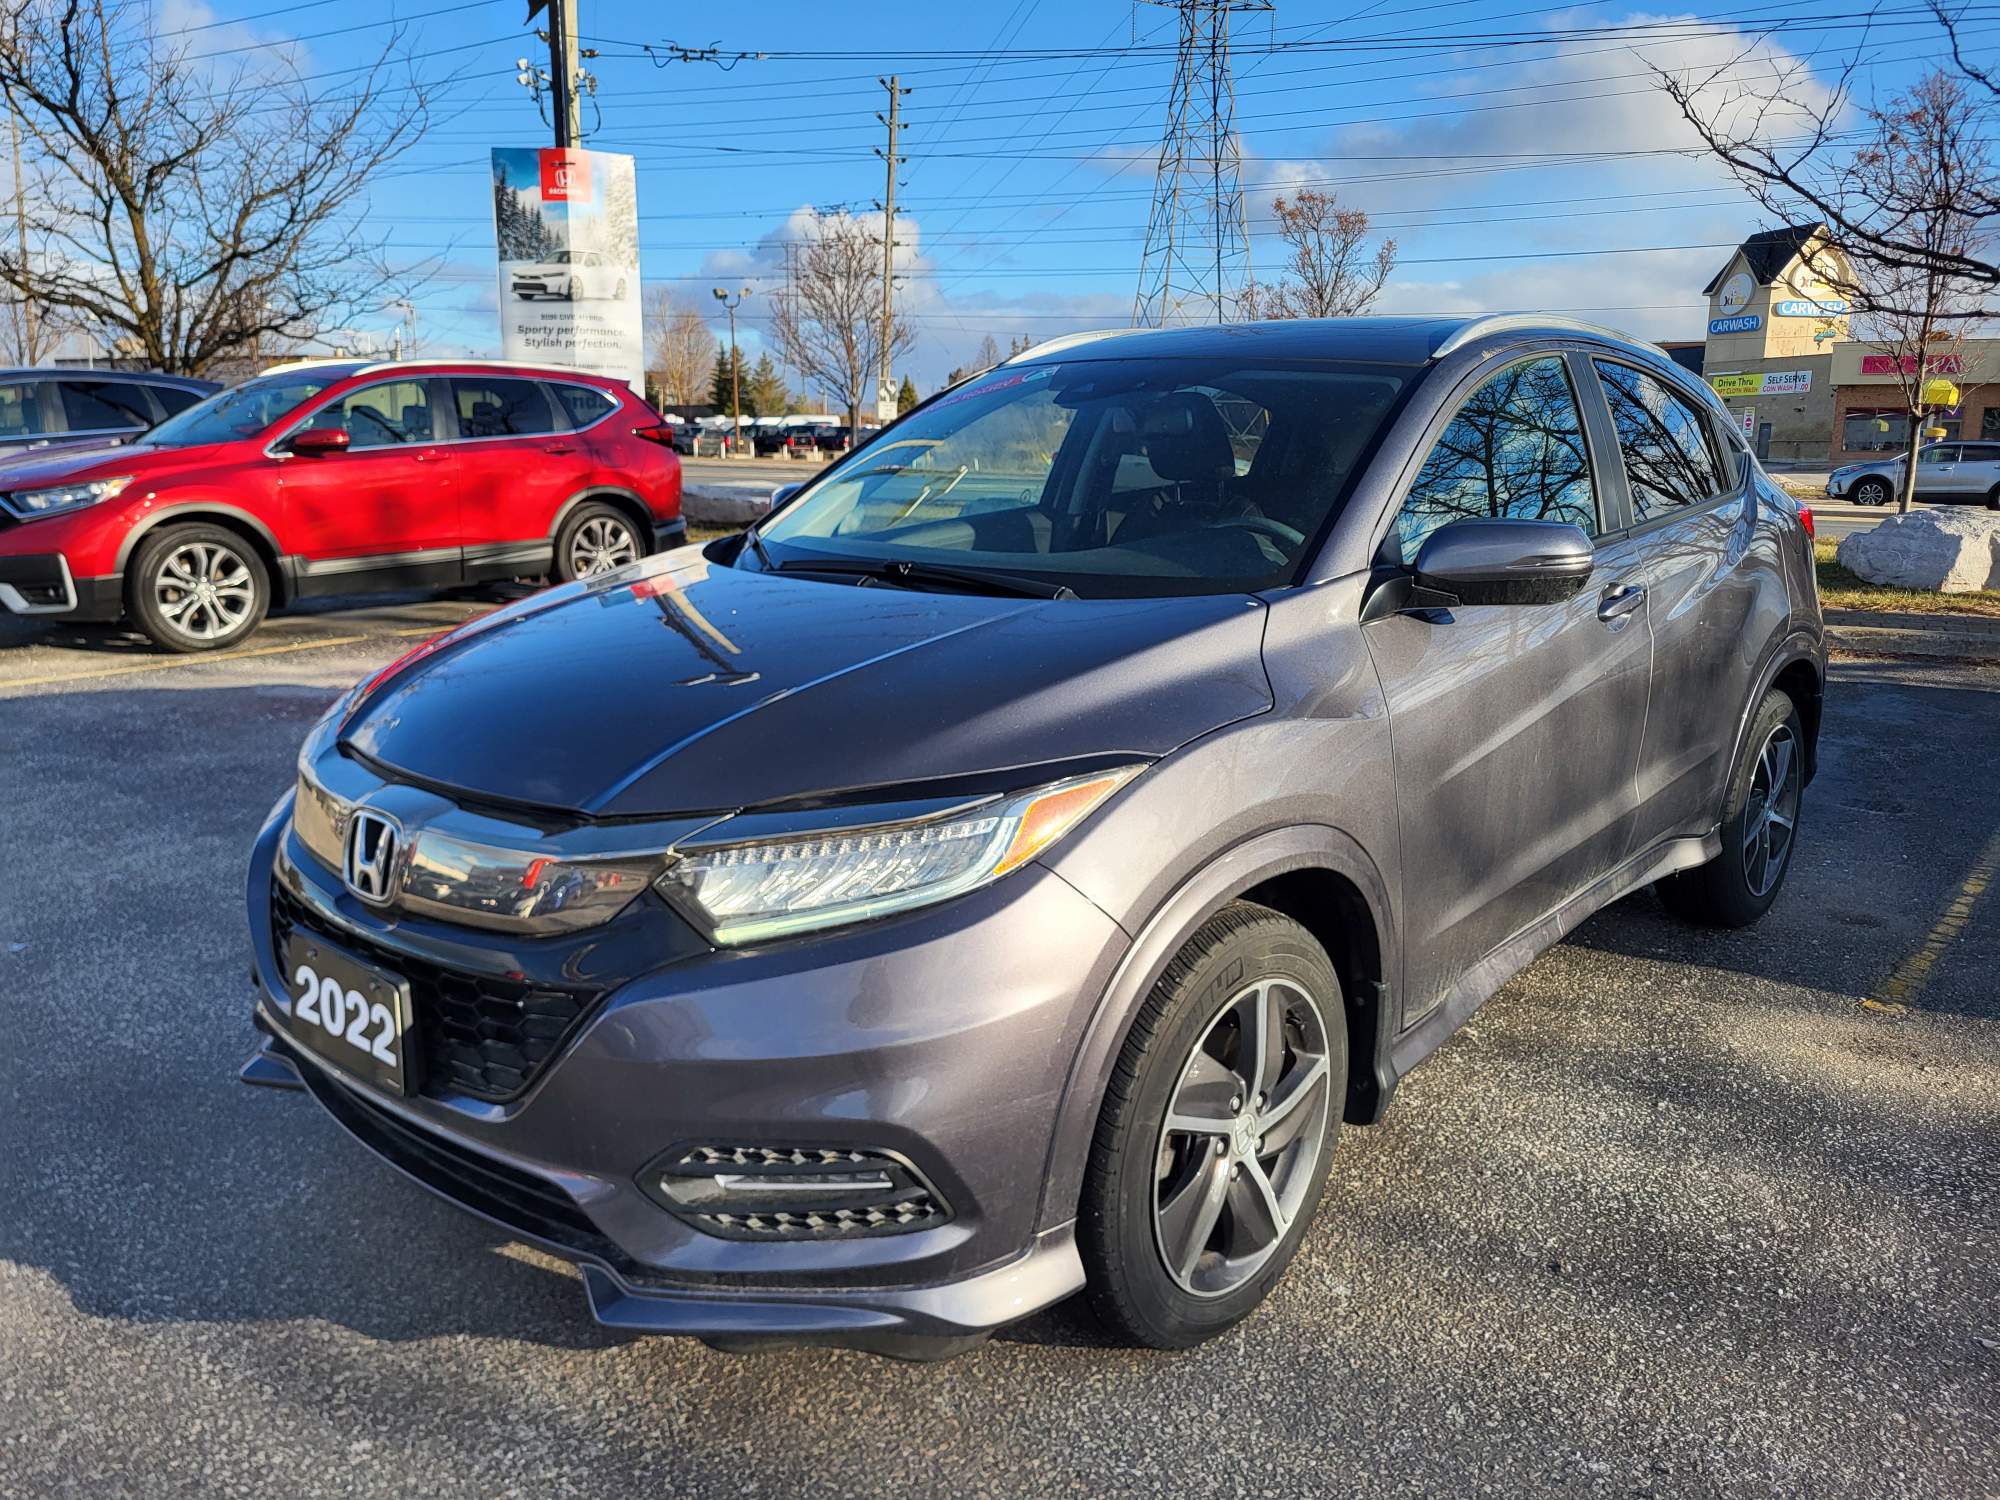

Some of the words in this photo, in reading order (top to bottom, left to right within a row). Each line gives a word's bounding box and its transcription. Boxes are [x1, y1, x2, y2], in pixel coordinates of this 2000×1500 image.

[1781, 301, 1844, 316] CARWASH
[516, 324, 555, 336] Sporty
[1710, 316, 1757, 333] CARWASH
[524, 338, 562, 349] Stylish
[1718, 379, 1736, 387] Drive
[1738, 377, 1753, 386] Thru
[1768, 375, 1783, 384] SELF
[1784, 374, 1807, 384] SERVE
[294, 964, 398, 1068] 2022
